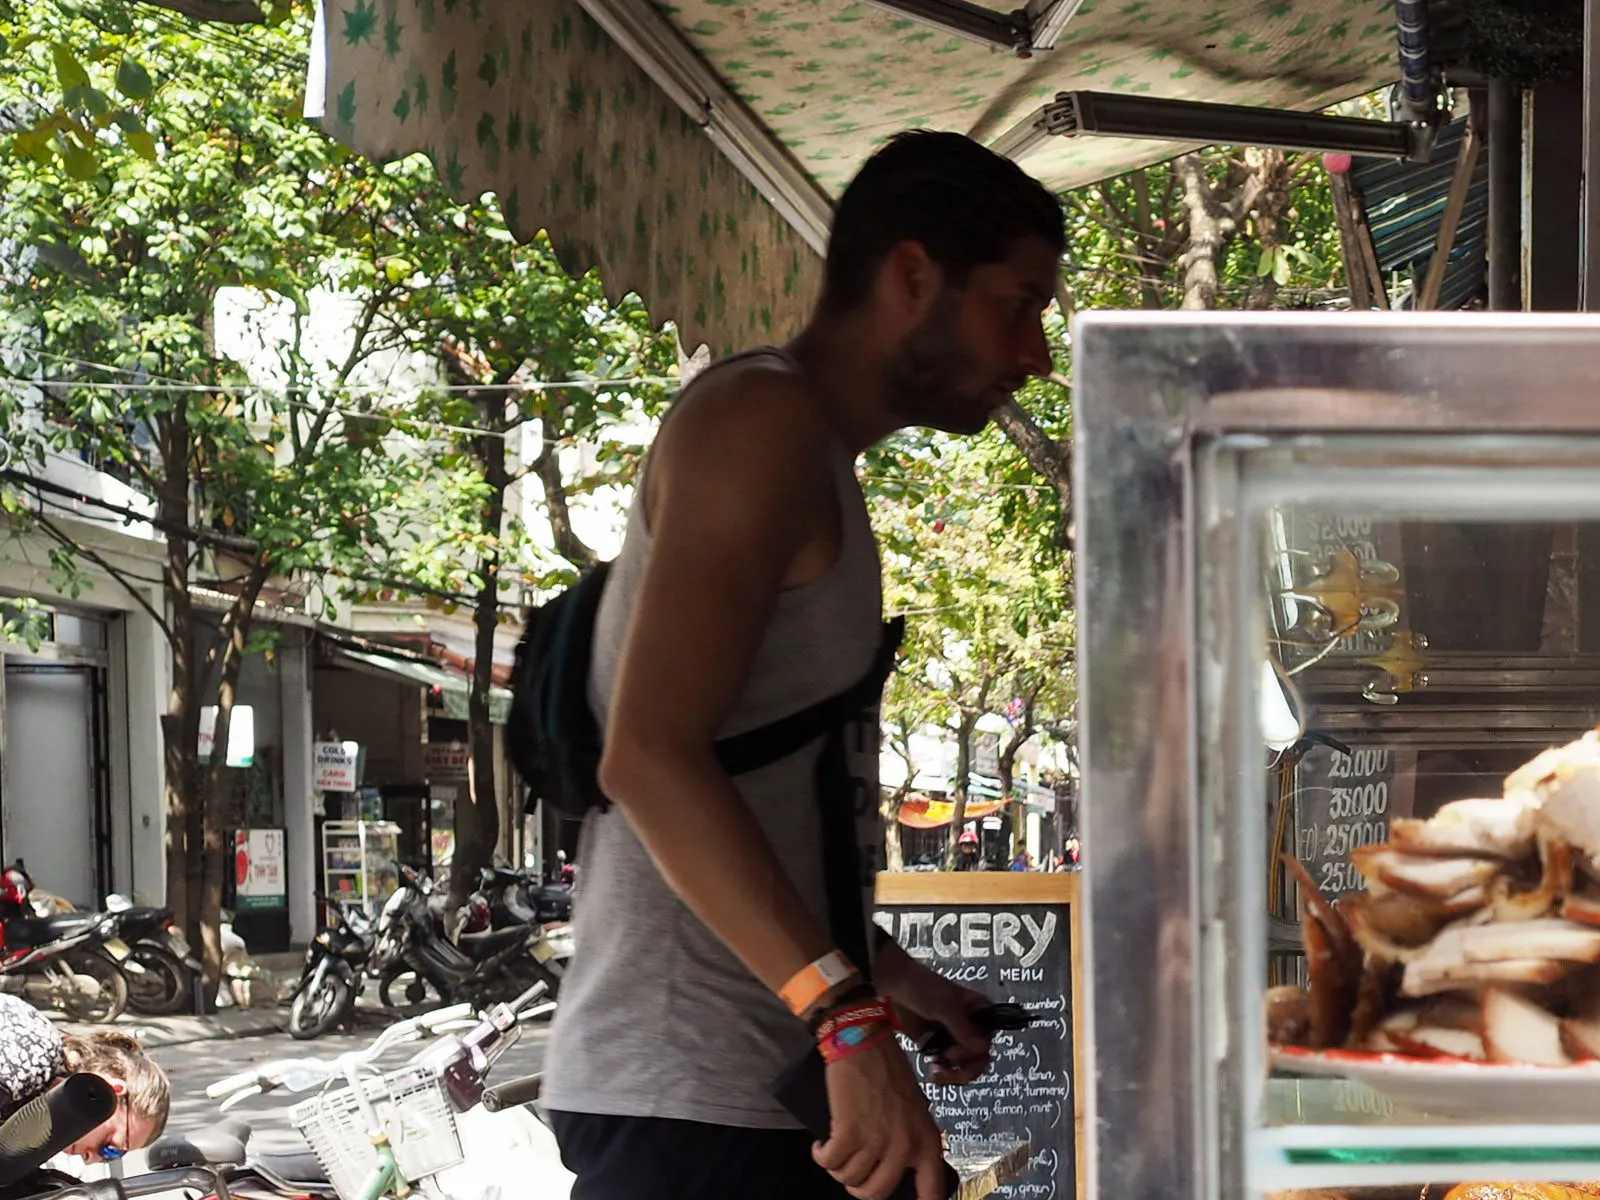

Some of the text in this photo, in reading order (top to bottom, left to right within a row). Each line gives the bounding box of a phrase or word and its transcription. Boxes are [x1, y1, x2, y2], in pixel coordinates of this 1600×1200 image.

[317, 755, 352, 766] DRINKS
[1328, 749, 1389, 779] 25.000
[872, 911, 1057, 968] UICERY
[932, 960, 989, 981] uice
